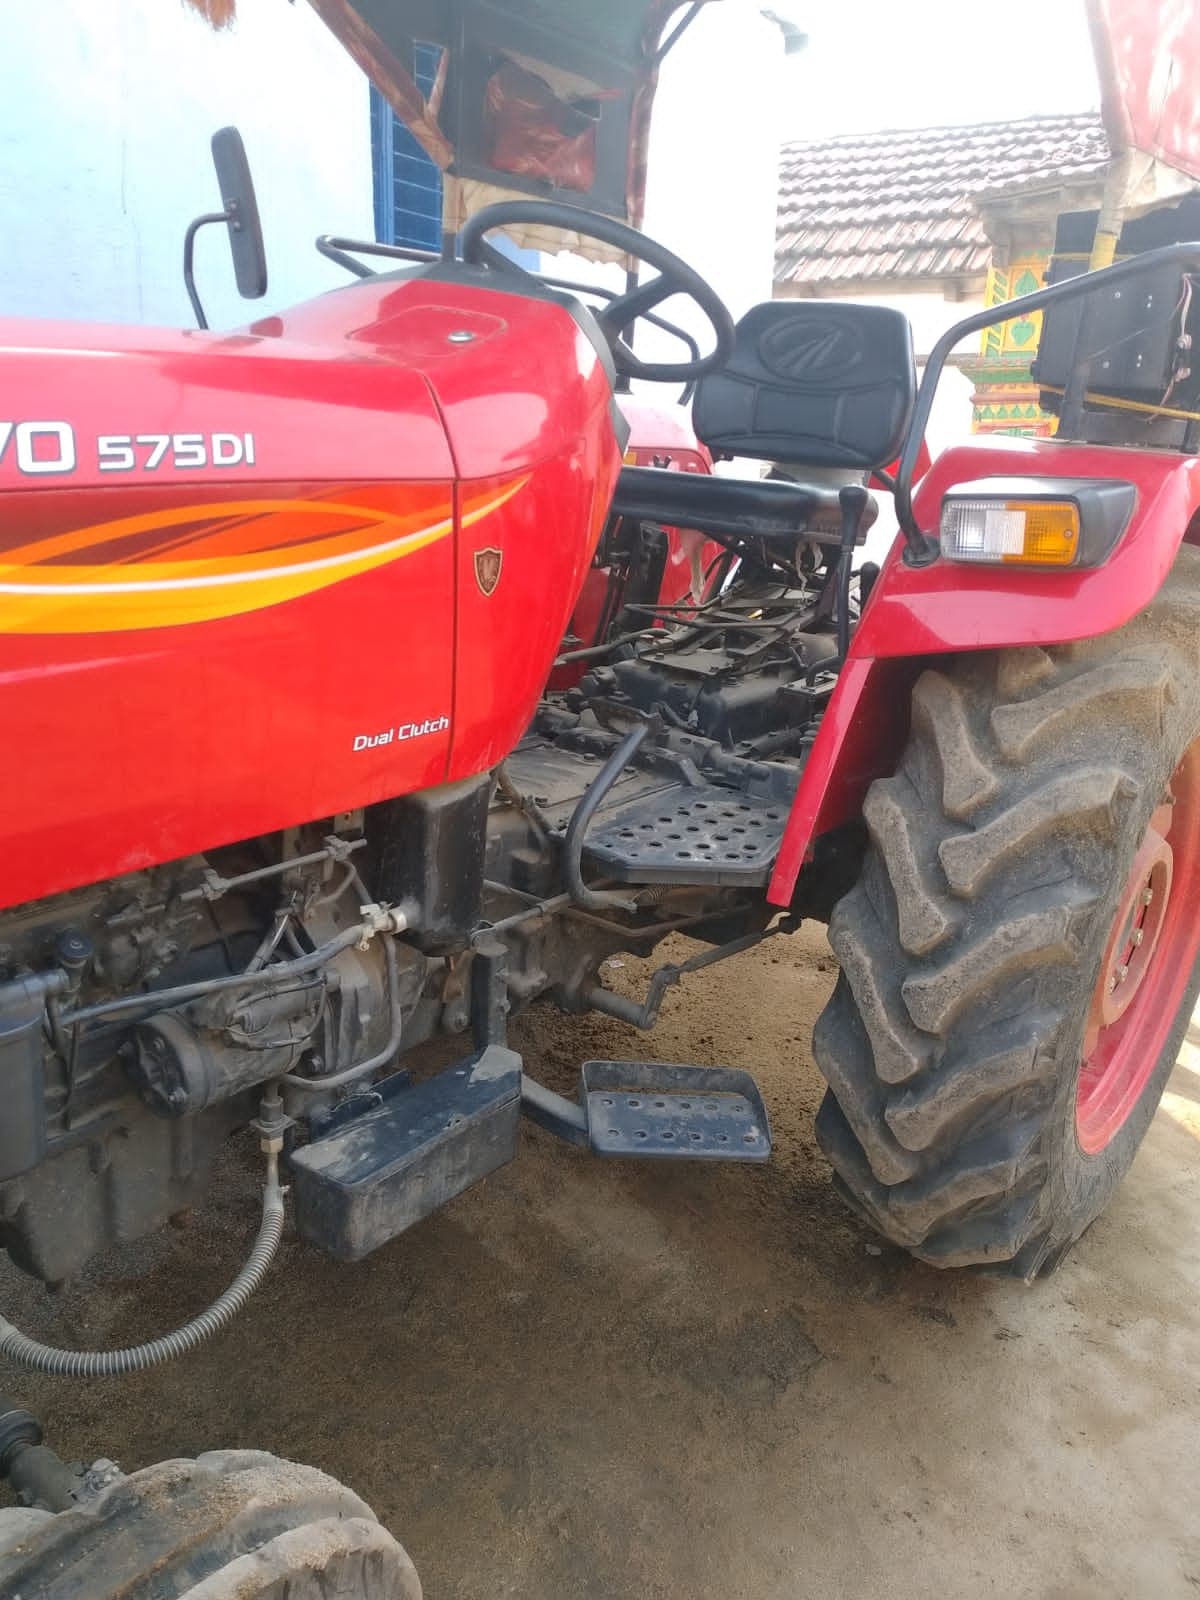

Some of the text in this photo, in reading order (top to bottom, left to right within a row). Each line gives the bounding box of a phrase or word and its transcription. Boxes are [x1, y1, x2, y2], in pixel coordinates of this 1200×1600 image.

[0, 420, 255, 475] O 575DI
[352, 715, 449, 752] Dual Clutch
